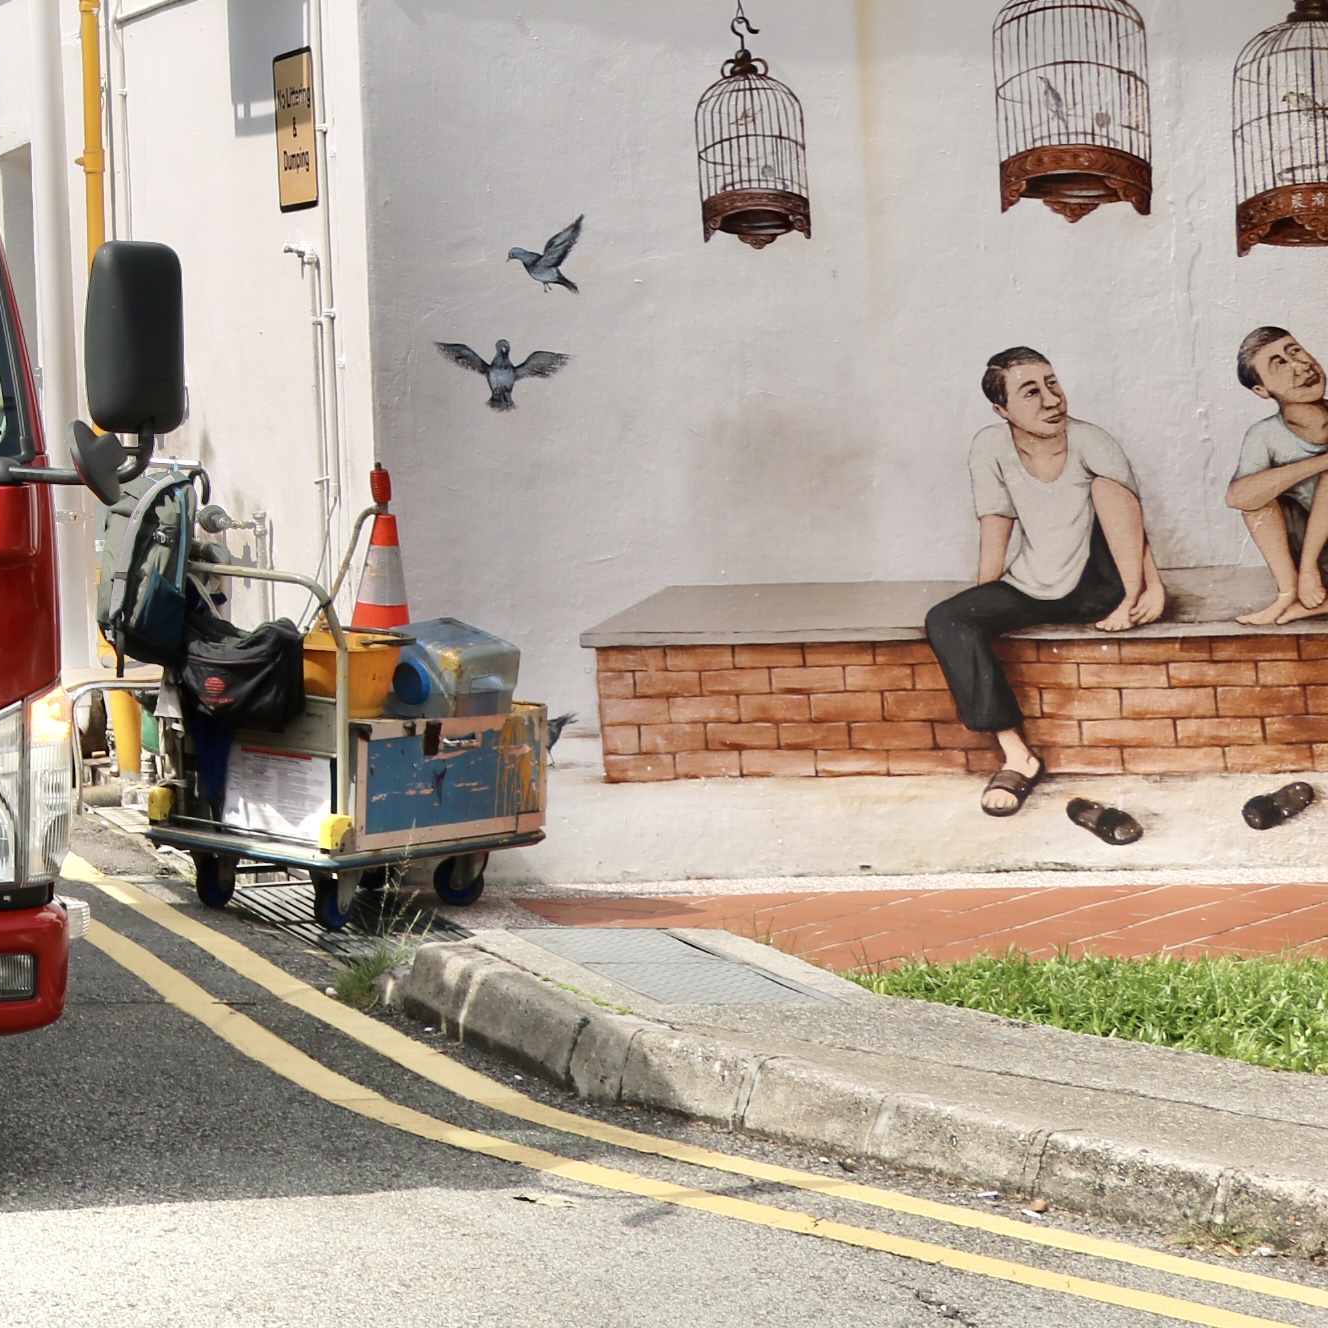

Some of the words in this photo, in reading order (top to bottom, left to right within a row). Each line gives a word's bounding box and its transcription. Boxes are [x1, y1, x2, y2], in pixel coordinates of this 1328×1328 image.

[277, 87, 285, 110] No
[286, 83, 311, 109] Littering
[283, 147, 310, 174] Dumping
